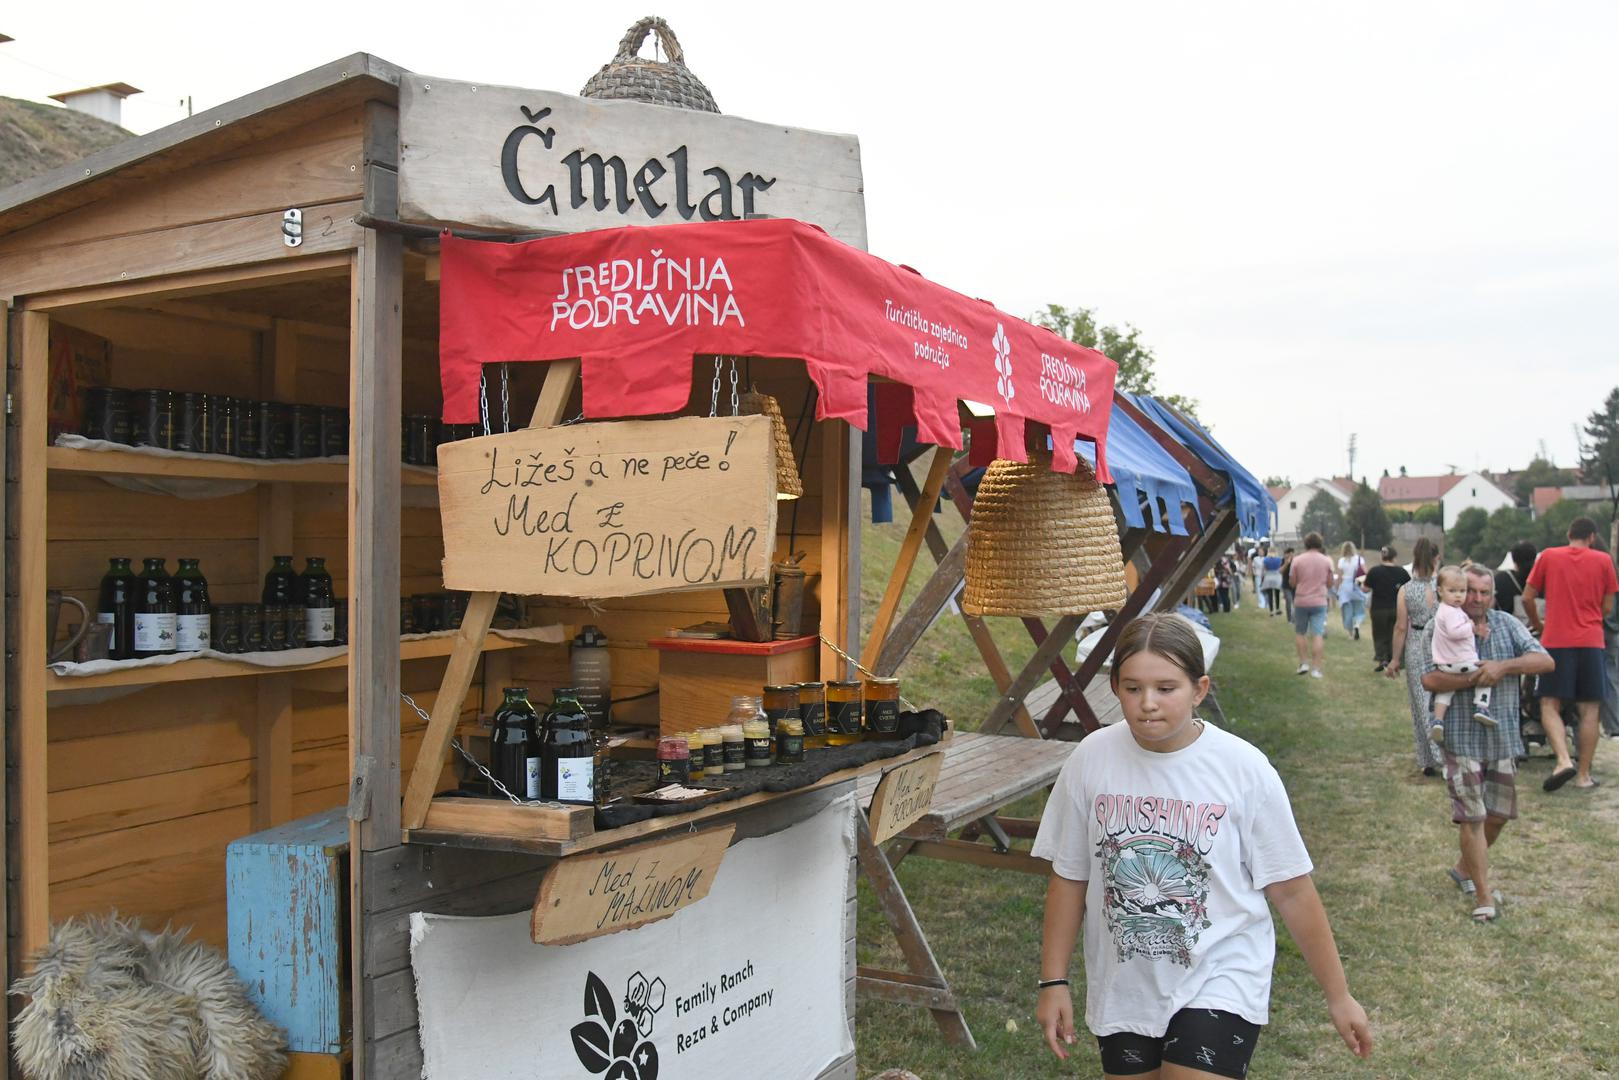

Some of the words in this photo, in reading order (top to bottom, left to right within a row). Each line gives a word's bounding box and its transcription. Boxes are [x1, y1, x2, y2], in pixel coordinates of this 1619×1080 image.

[501, 105, 777, 222] Čmelar
[557, 249, 733, 300] SREDIŠNJA
[550, 292, 745, 332] PODRAVINA
[884, 299, 929, 334] Turistička
[930, 319, 968, 350] zajednica
[913, 341, 950, 370] područja
[1040, 375, 1091, 416] PODRAVINA
[480, 447, 575, 494] Ližeš
[622, 457, 649, 479] ne
[494, 492, 578, 536] Med
[544, 526, 757, 583] KOPRIVOM
[1095, 794, 1227, 855] SUNSHINE
[589, 857, 641, 895] Med
[597, 867, 703, 929] MALINOM
[1113, 921, 1195, 951] Paradise
[675, 982, 717, 1018] Family
[720, 959, 755, 993] Ranch
[677, 1028, 706, 1054] Reza
[710, 1015, 719, 1034] &
[722, 988, 775, 1027] Company
